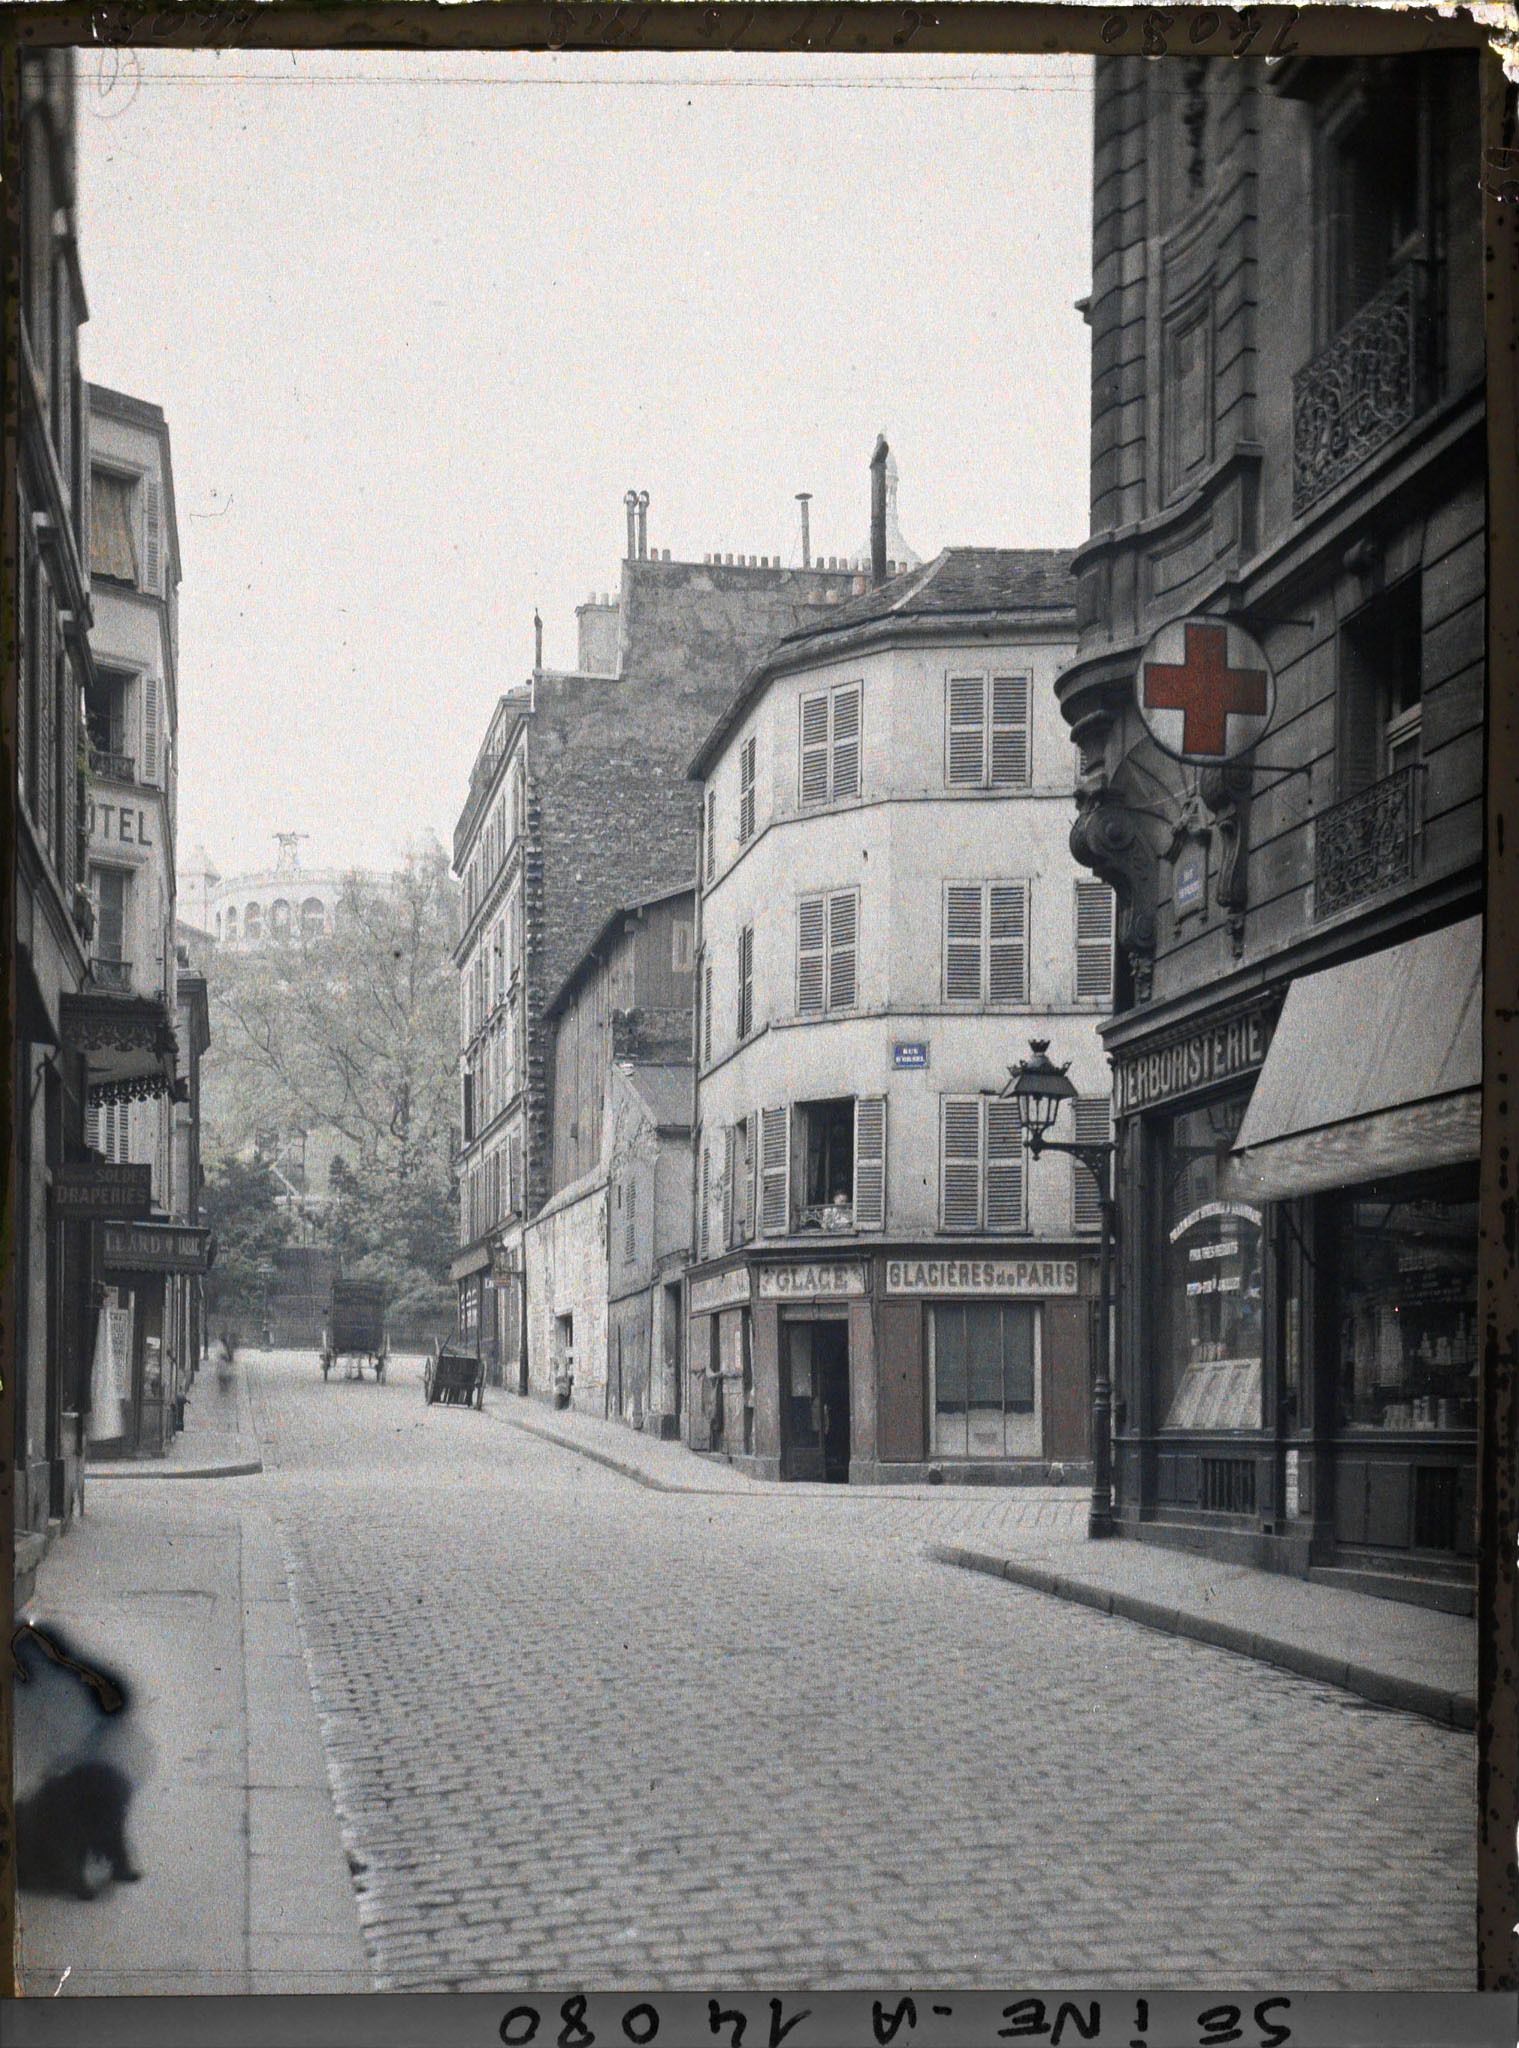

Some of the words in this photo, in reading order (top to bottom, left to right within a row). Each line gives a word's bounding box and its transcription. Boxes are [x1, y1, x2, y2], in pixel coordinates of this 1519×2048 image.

[1115, 1014, 1263, 1112] HERBORISTERIE
[775, 1264, 849, 1289] GLACE
[889, 1261, 995, 1287] GLACIÈRES
[996, 1269, 1015, 1287] de
[1016, 1263, 1076, 1287] PARIS
